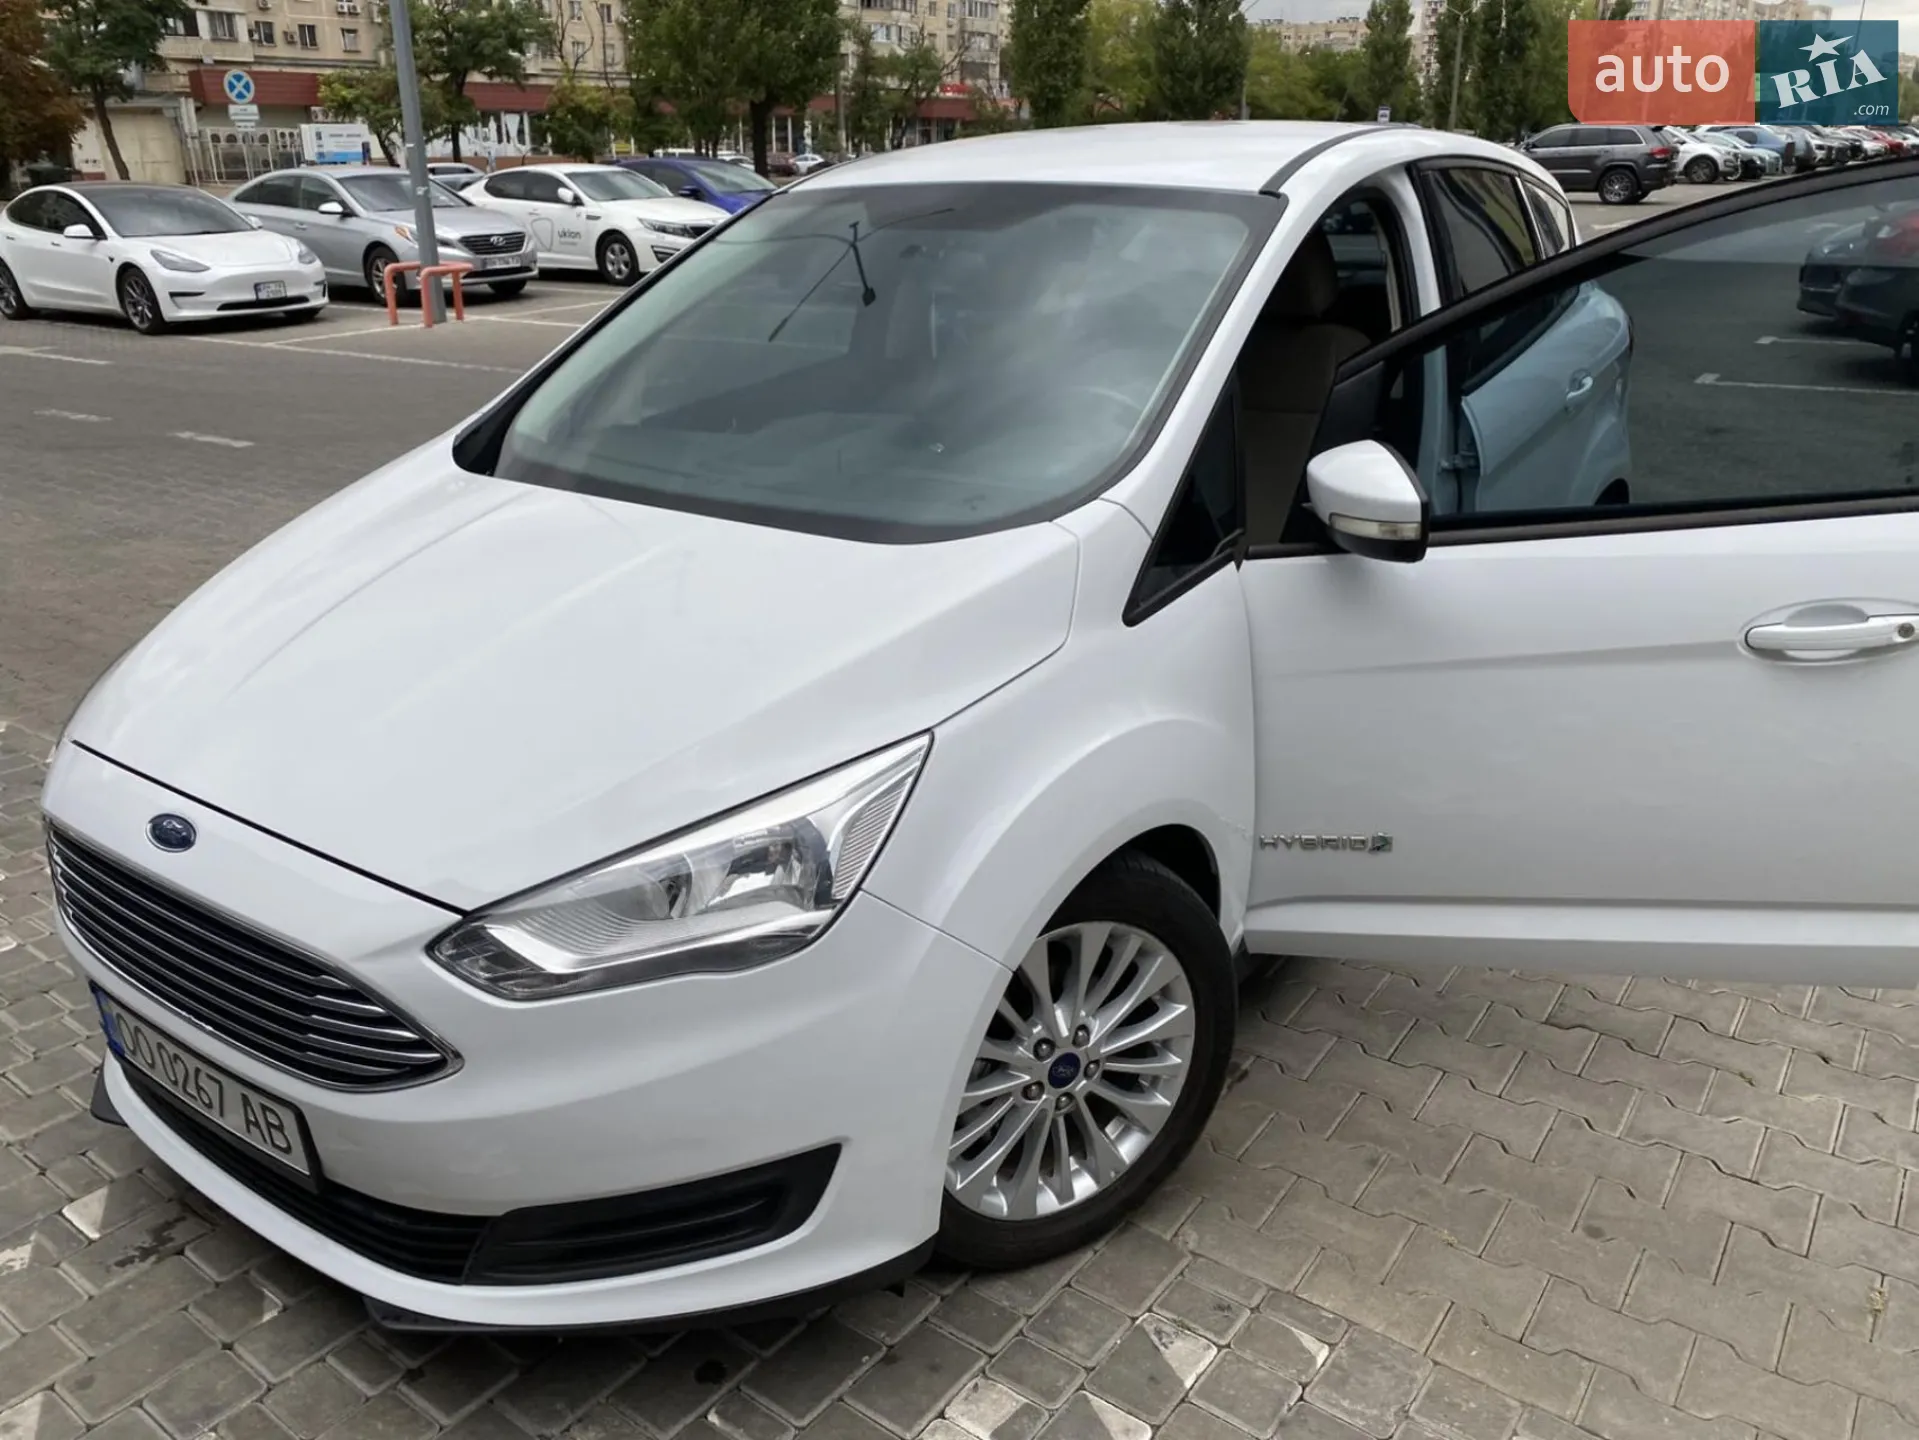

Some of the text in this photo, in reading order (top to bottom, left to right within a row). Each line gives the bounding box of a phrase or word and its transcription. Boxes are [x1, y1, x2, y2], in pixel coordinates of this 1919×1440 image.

[1259, 834, 1369, 850] HYBRID
[156, 1040, 224, 1119] 0267
[240, 1090, 293, 1156] AB
